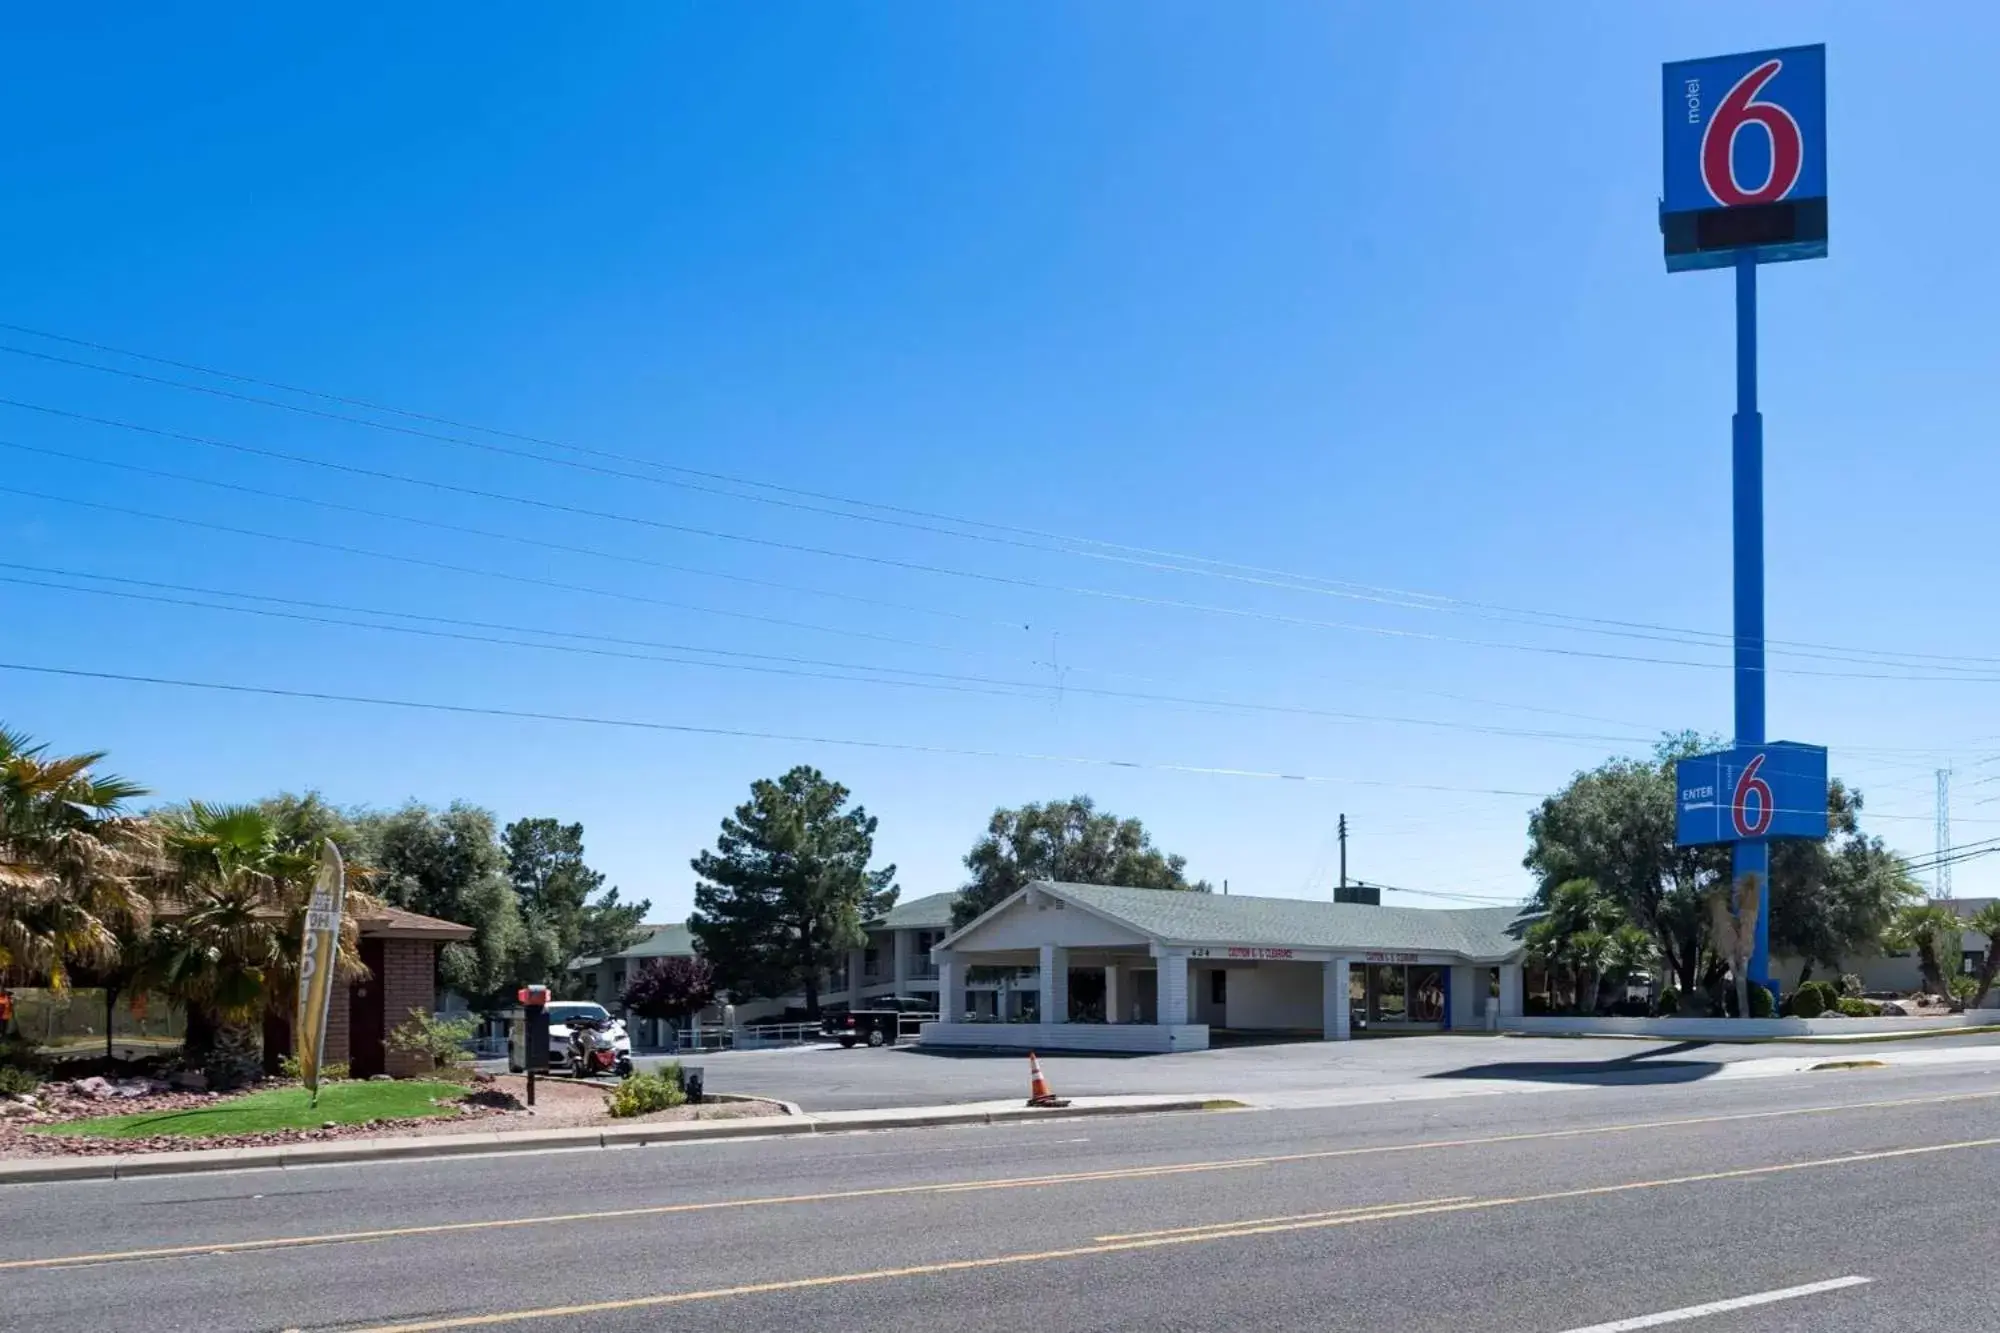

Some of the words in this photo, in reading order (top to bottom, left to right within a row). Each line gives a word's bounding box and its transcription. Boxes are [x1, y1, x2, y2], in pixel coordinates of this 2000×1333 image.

[1685, 78, 1700, 124] motel
[1700, 58, 1804, 207] 6
[1682, 785, 1714, 801] ENTER
[1731, 752, 1774, 837] 6
